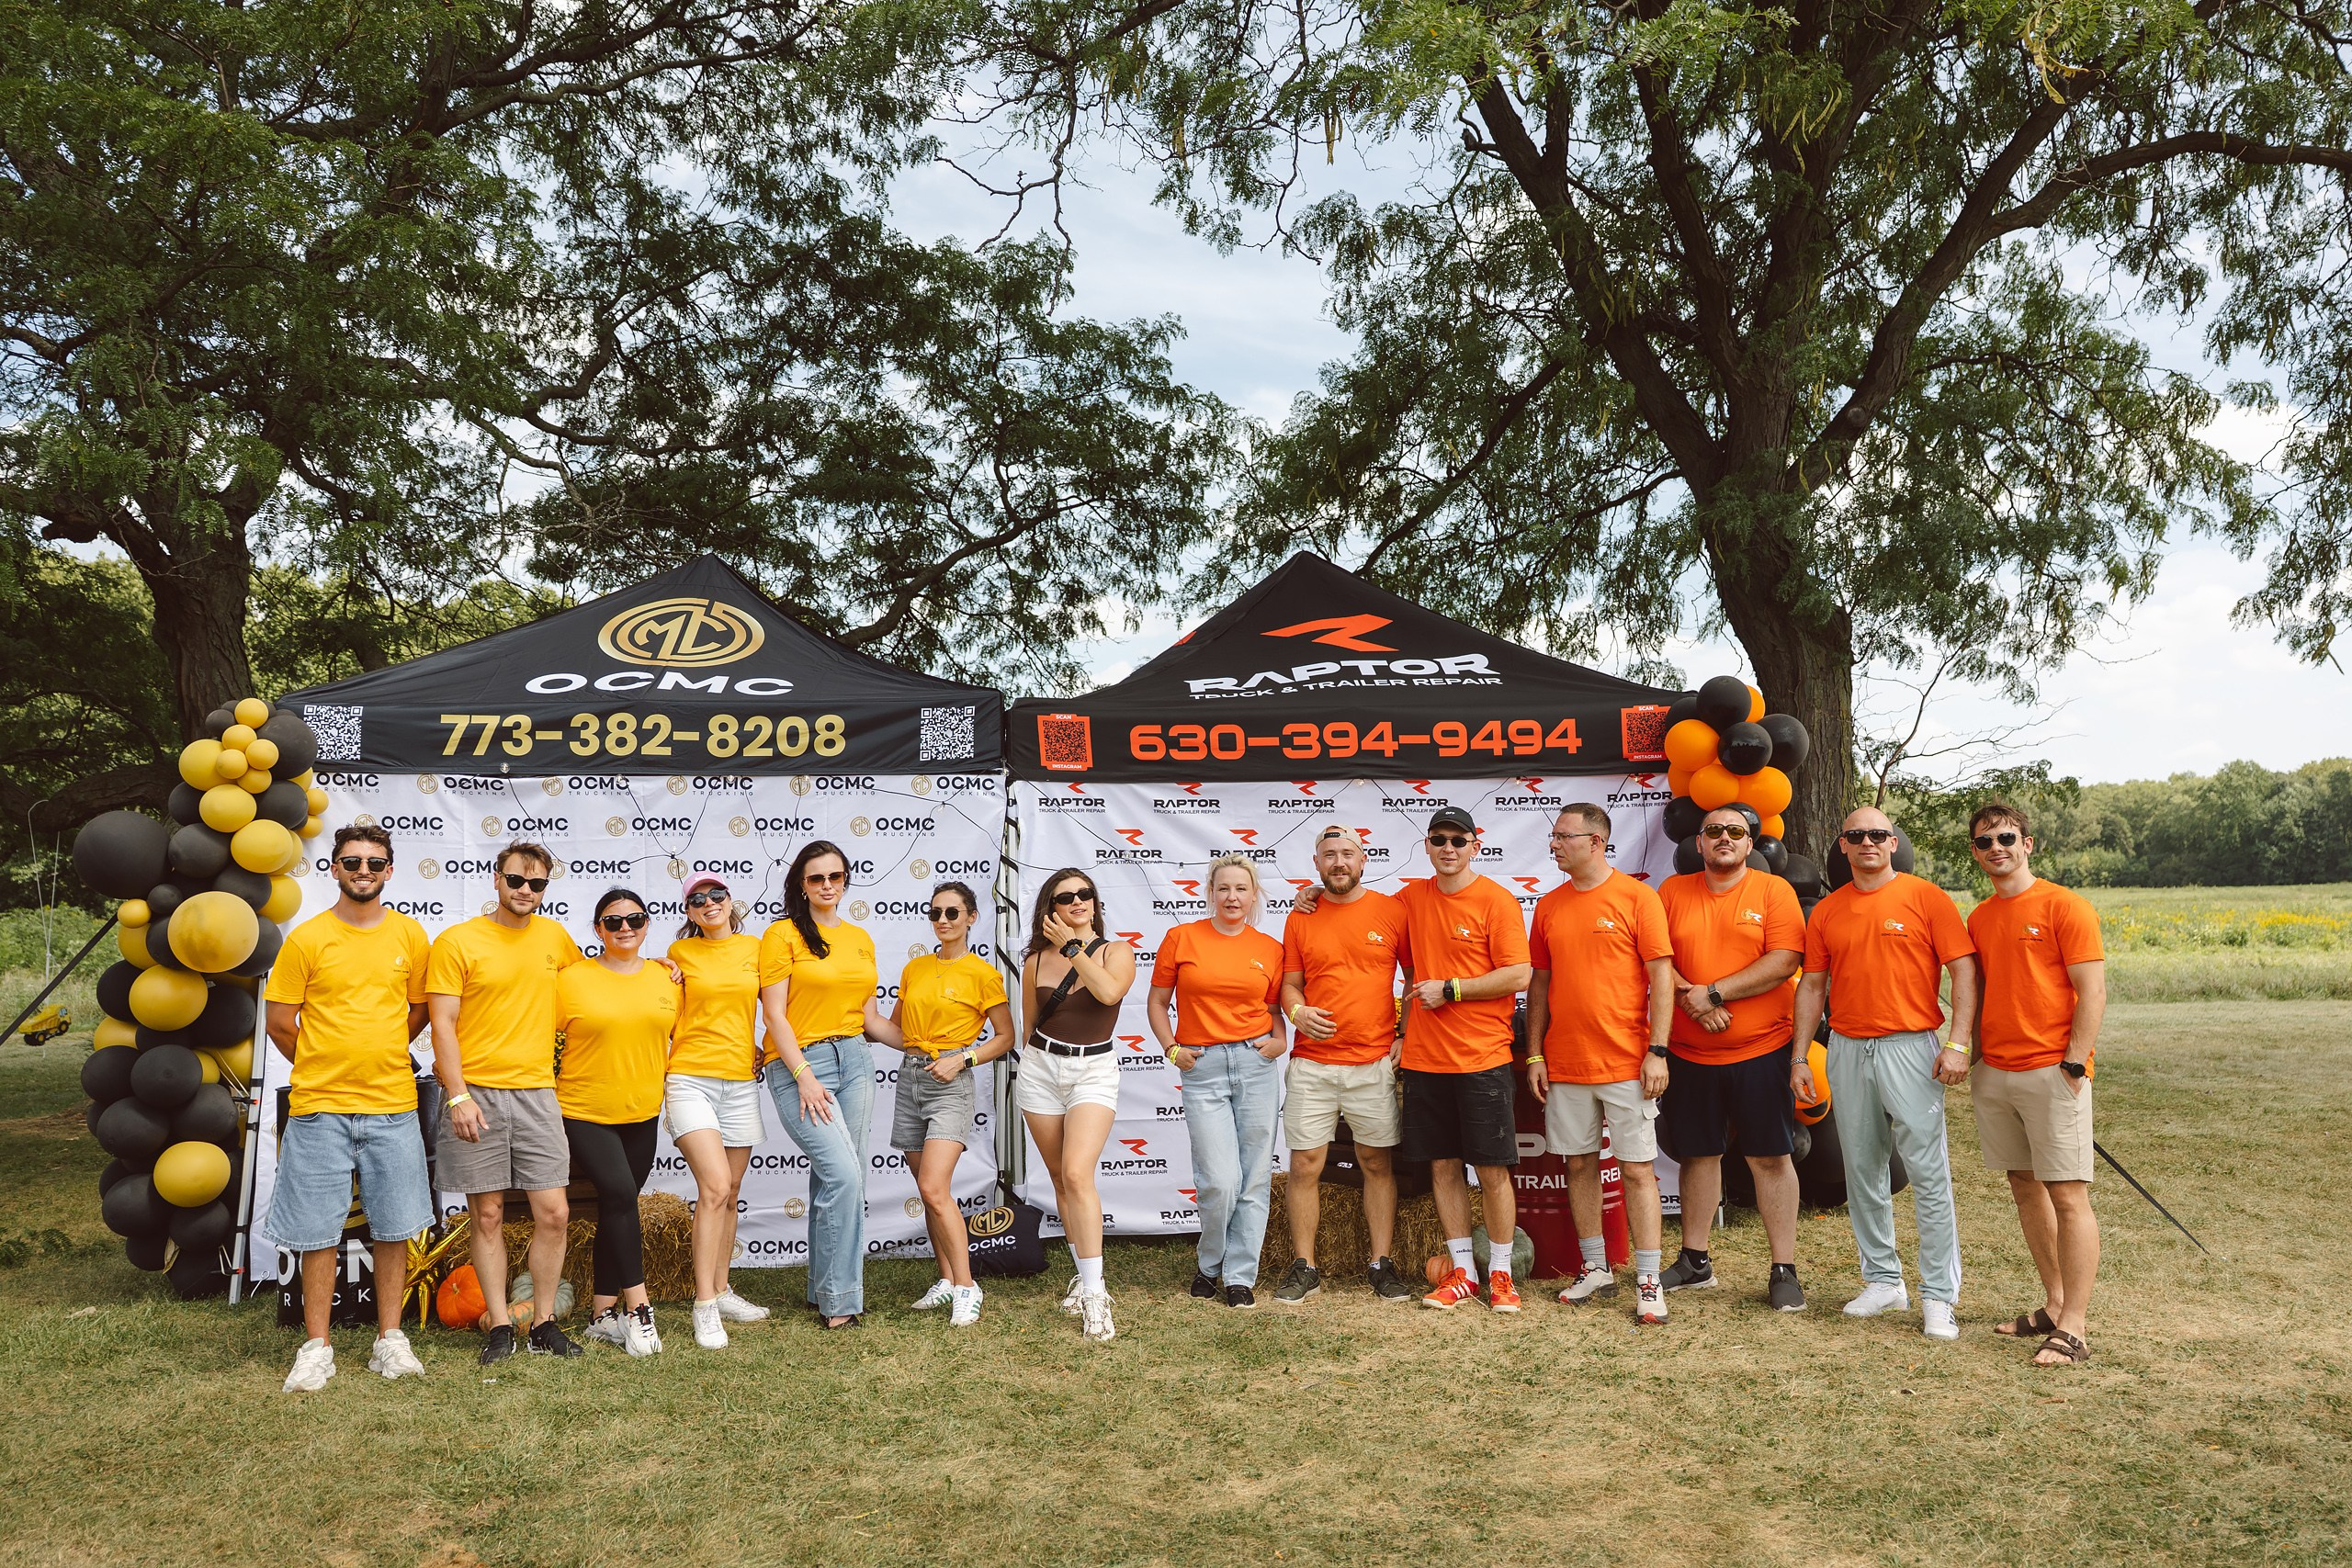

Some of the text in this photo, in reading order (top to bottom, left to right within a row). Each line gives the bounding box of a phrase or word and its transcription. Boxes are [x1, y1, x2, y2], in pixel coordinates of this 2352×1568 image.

[1183, 653, 1500, 693] RAPTOR
[526, 671, 795, 695] OCMC
[1281, 685, 1297, 694] &
[1303, 679, 1408, 691] TRAILER
[1412, 676, 1503, 686] REPAIR
[440, 713, 845, 758] 773-382-8208
[1130, 717, 1583, 760] 630-394-9494
[316, 773, 379, 785] OCMC
[444, 776, 504, 791] OCMC
[568, 776, 630, 790] OCMC
[692, 776, 753, 790] OCMC
[815, 776, 876, 790] OCMC
[936, 776, 996, 791] OCMC
[1038, 798, 1106, 807] RAPTOR
[1153, 799, 1220, 808] RAPTOR
[1268, 799, 1335, 808] RAPTOR
[1382, 798, 1449, 807] RAPTOR
[1495, 796, 1562, 806] RAPTOR
[1607, 792, 1673, 803] RAPTOR
[381, 816, 444, 829] OCMC
[507, 818, 569, 831] OCMC
[632, 818, 692, 831] OCMC
[754, 818, 815, 831] OCMC
[876, 818, 935, 831] OCMC
[571, 860, 631, 874] OCMC
[693, 860, 753, 874] OCMC
[851, 861, 874, 874] MC
[935, 860, 990, 874] OCMC
[538, 902, 569, 916] MC
[754, 902, 783, 916] OC
[1153, 900, 1206, 909] RAPTO
[876, 986, 899, 998] OC
[876, 1070, 898, 1083] OC
[655, 1156, 687, 1170] MC
[750, 1156, 810, 1169] OCMC
[872, 1155, 909, 1168] OCM
[1101, 1159, 1168, 1170] RAPTOR
[1514, 1174, 1567, 1190] TRAIL
[957, 1195, 986, 1209] MC
[1159, 1210, 1200, 1219] RAPT
[748, 1240, 808, 1254] OCMC
[868, 1237, 928, 1253] OCMC
[967, 1235, 1016, 1252] OCMC
